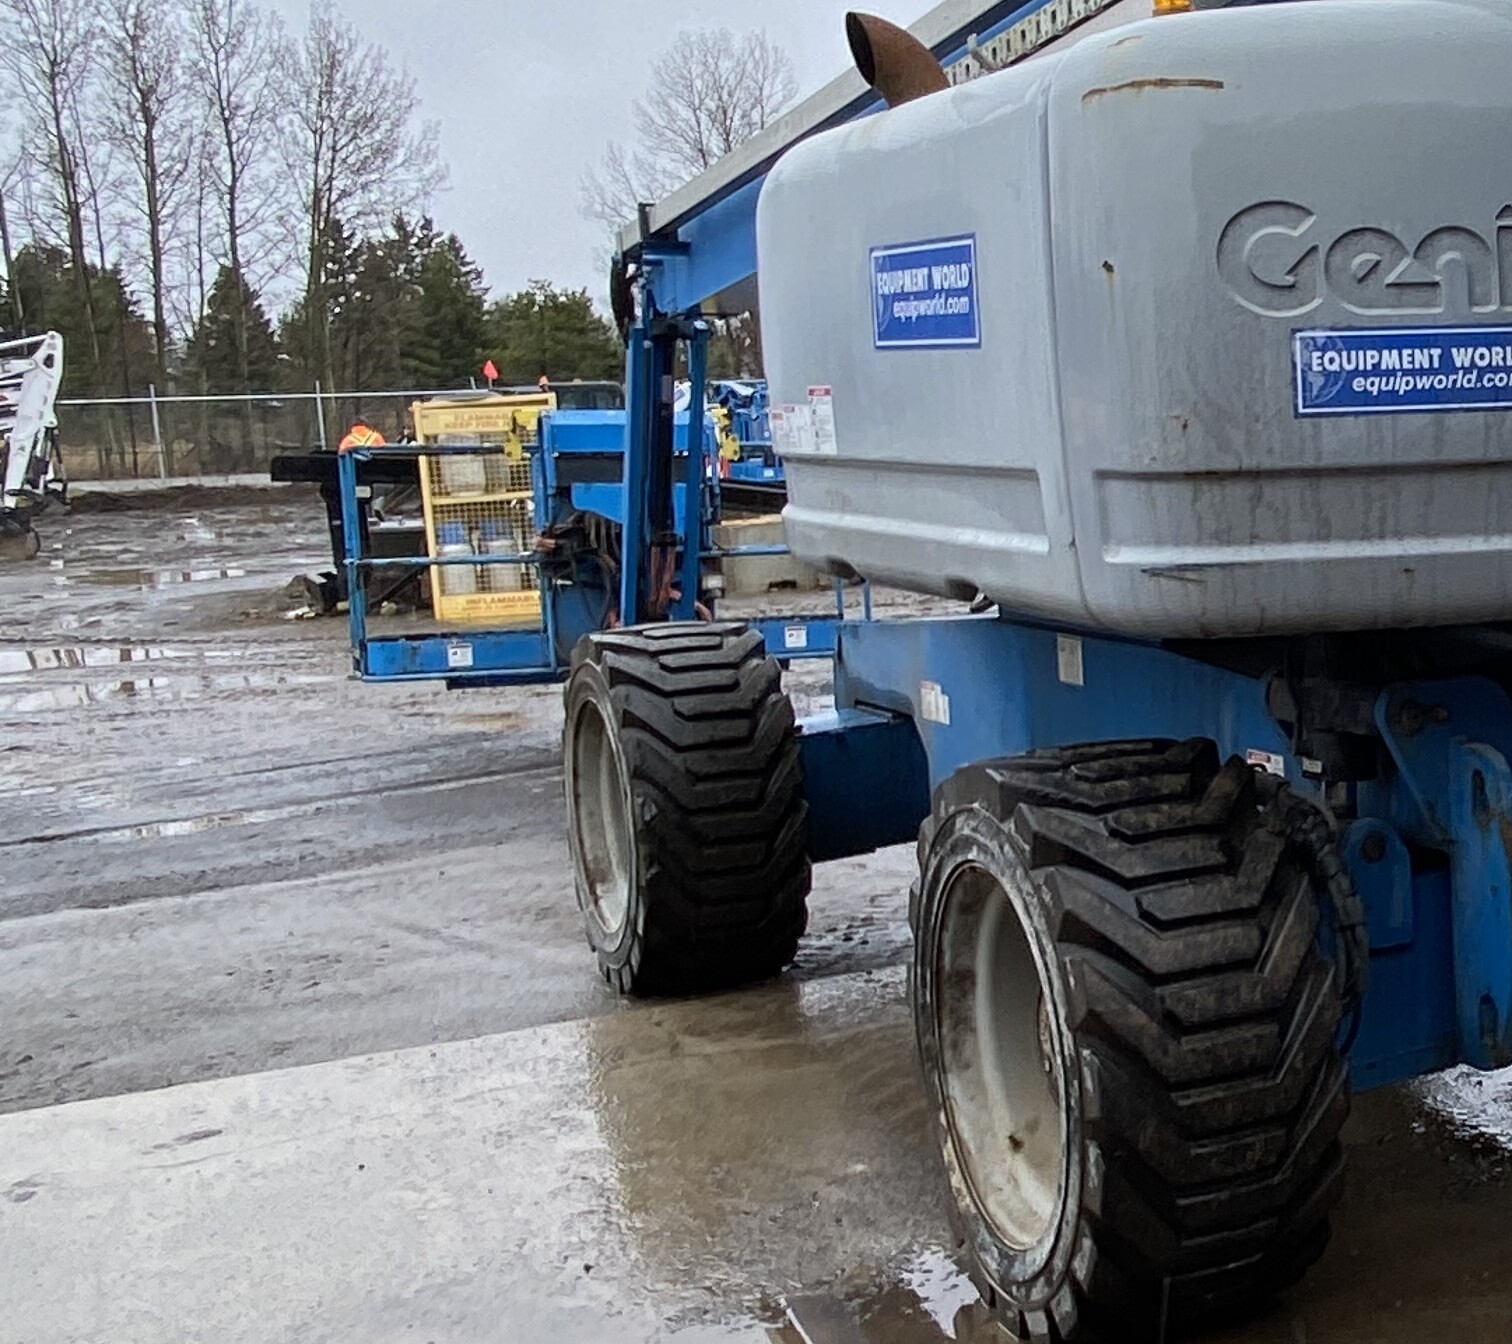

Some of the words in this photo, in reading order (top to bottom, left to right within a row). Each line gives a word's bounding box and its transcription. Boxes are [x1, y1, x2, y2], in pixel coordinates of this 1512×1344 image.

[876, 266, 929, 295] EQUIPMENT
[931, 263, 970, 290] WORLD
[893, 292, 970, 323] equipworld.com
[1311, 348, 1442, 372] EQUIPMENT
